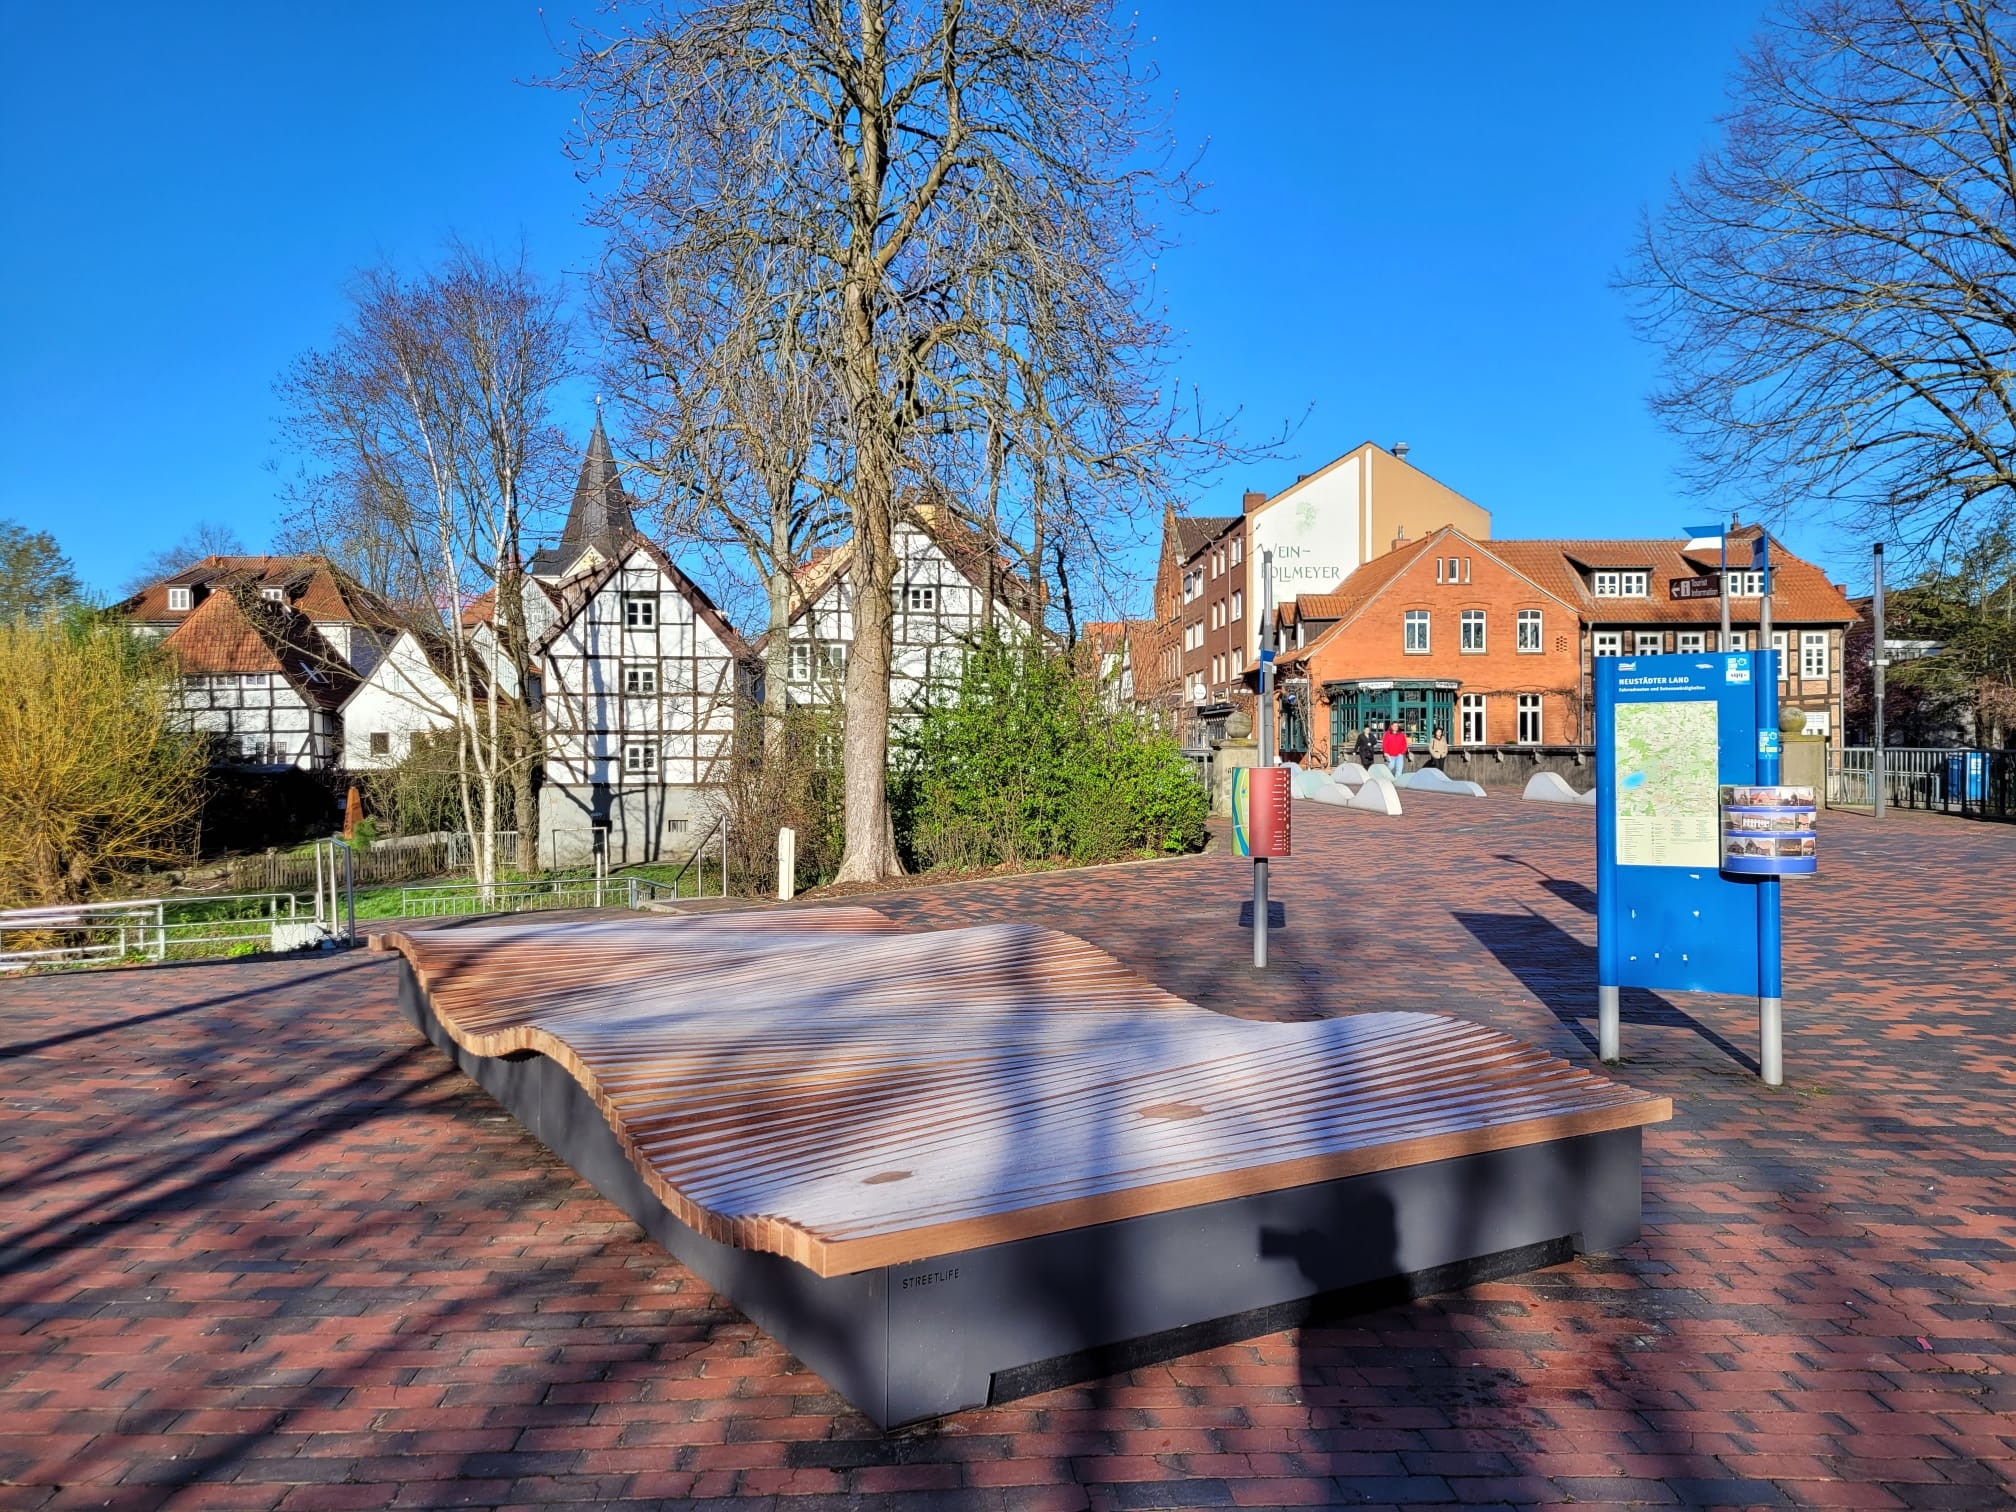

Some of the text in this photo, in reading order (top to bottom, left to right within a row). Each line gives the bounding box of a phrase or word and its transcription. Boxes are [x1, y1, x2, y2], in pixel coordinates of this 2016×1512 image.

[1618, 676, 1690, 686] NEUSTÄDTER LAND
[902, 1268, 960, 1289] STREETLIFE
